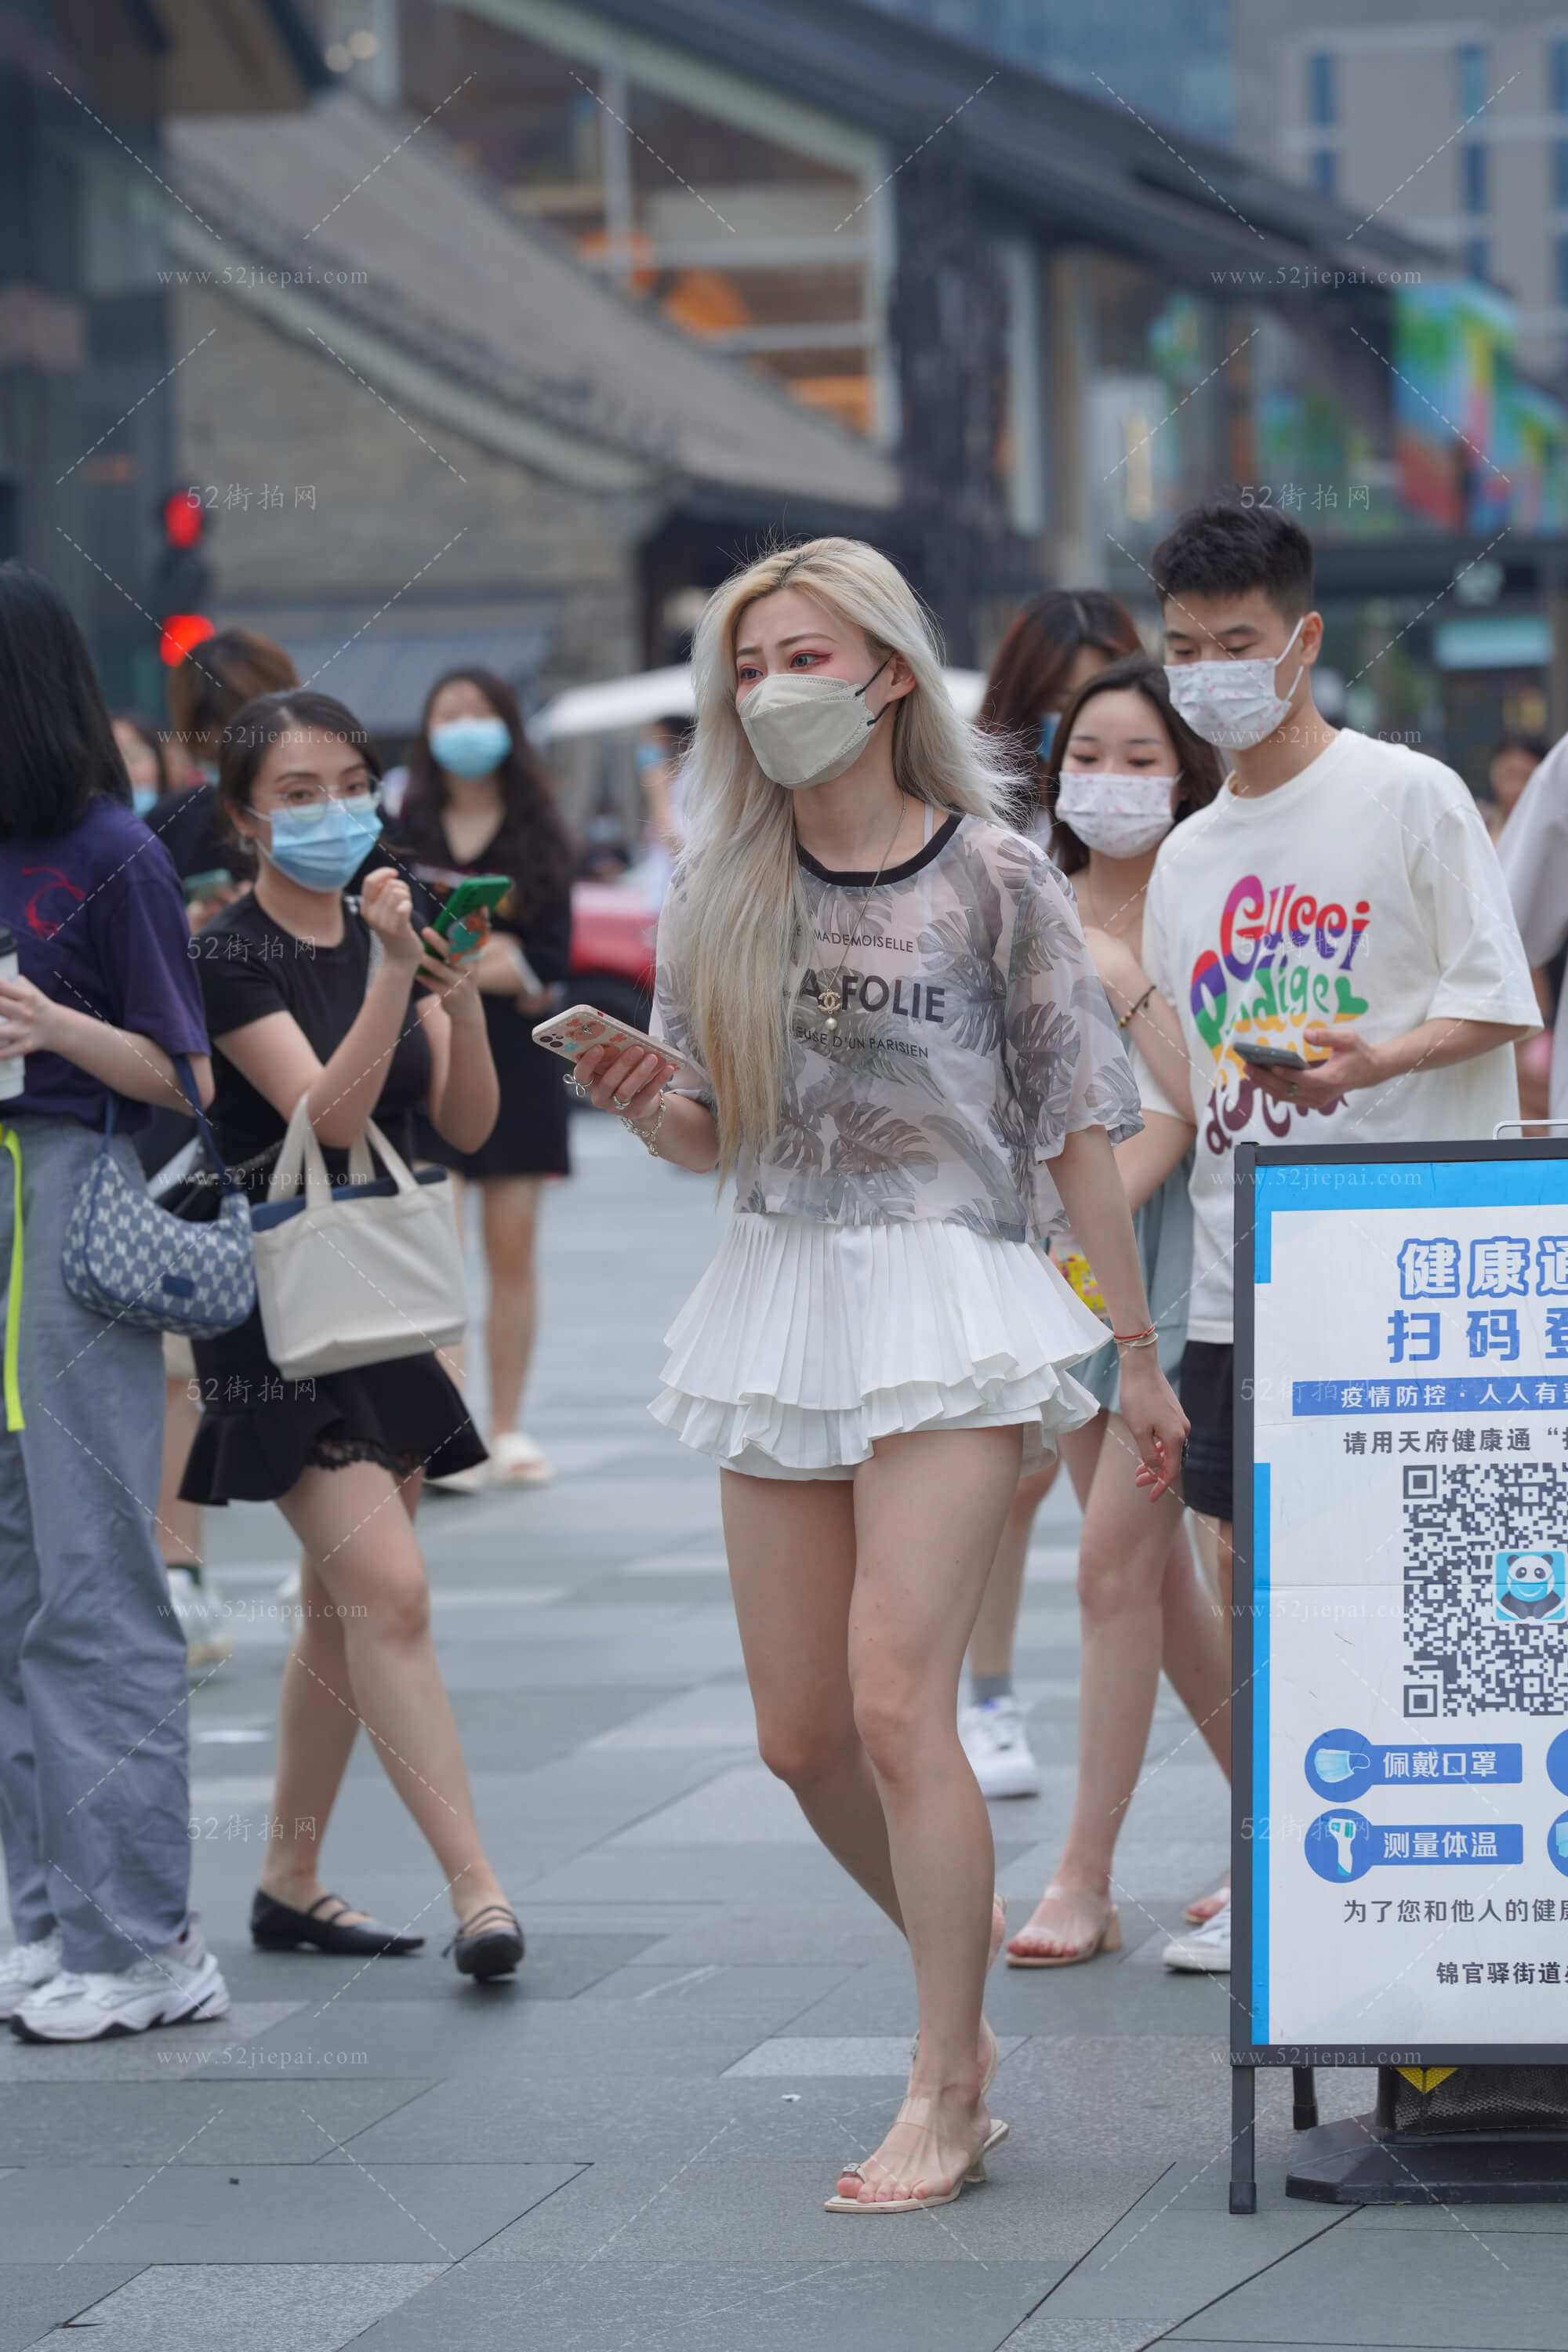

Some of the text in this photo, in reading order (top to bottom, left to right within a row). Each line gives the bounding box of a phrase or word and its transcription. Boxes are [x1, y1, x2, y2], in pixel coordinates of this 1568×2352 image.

[813, 928, 913, 953] MADEMOISELLE
[841, 975, 946, 1023] FOLIE
[793, 1026, 928, 1059] EUSE D'UN PARISIEN
[1341, 1382, 1568, 1409] 疫情防控·人人有
[1343, 1427, 1568, 1455] 请用天府健康通“
[1383, 1751, 1497, 1778] 佩戴口罩
[1383, 1831, 1498, 1859] 测量体温
[1436, 1961, 1568, 1985] 锦官驿街道
